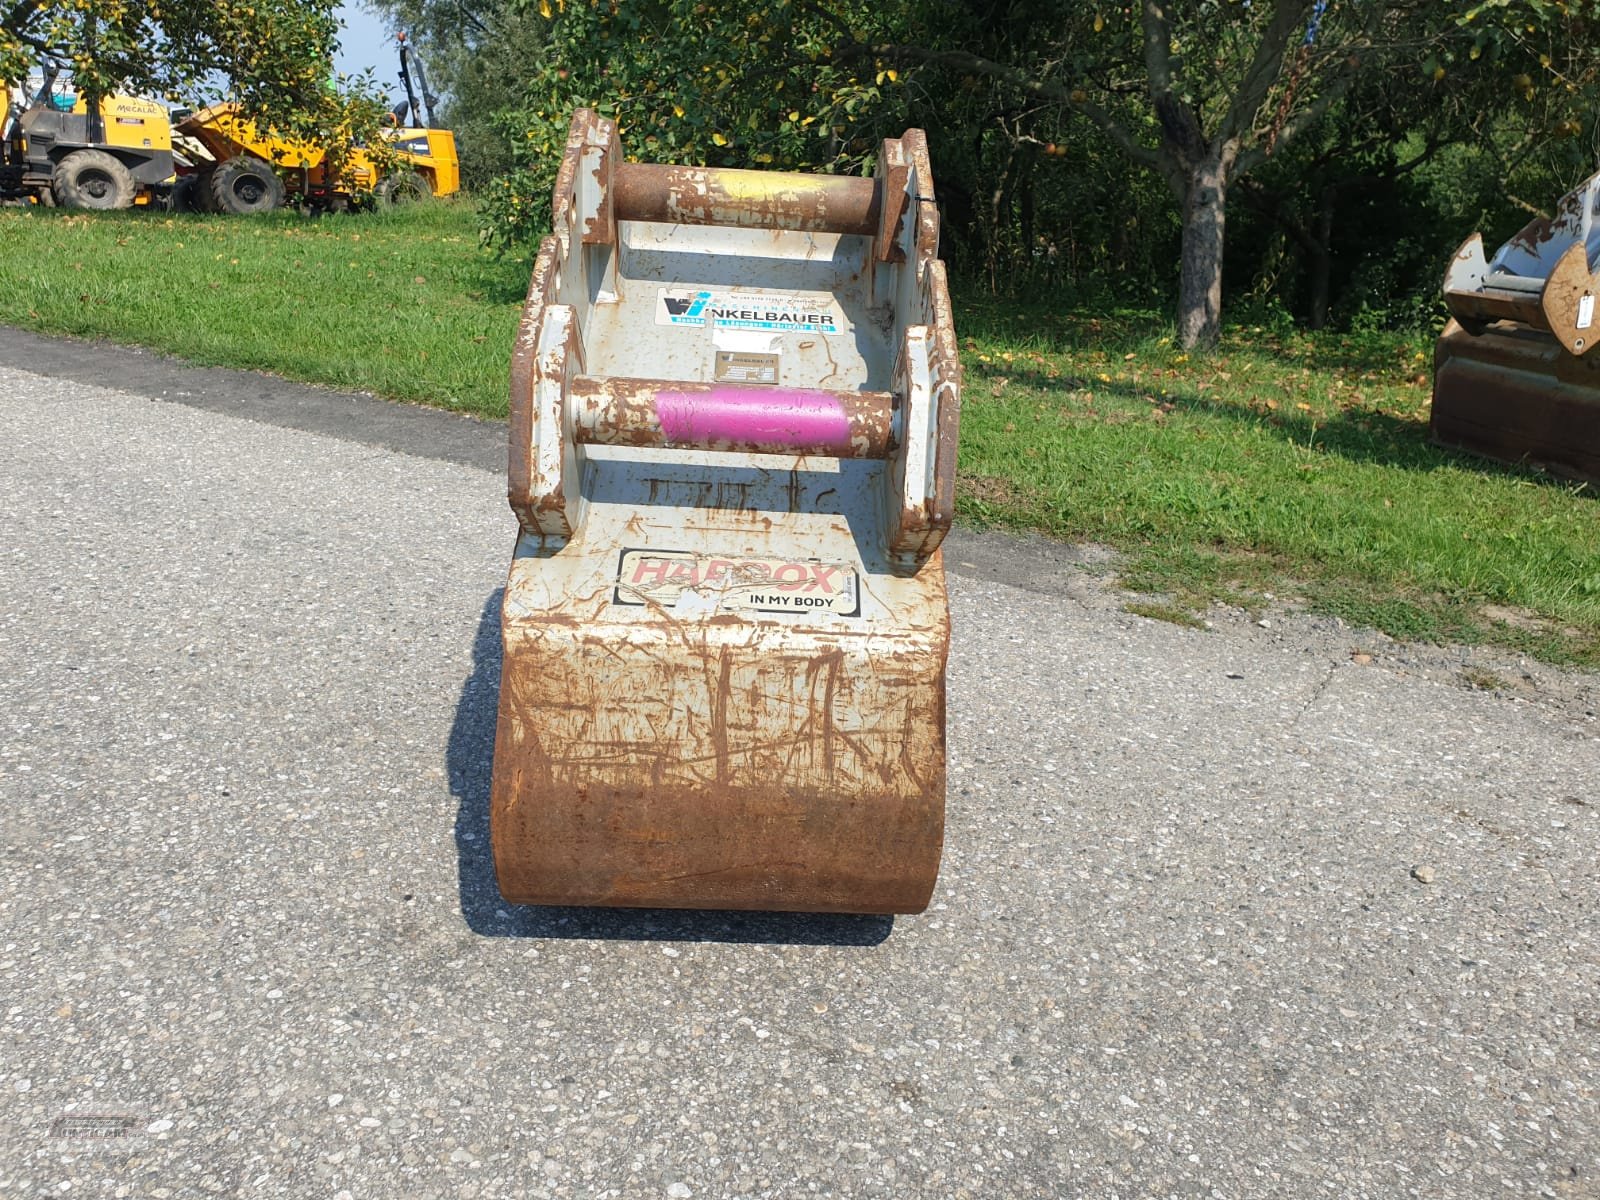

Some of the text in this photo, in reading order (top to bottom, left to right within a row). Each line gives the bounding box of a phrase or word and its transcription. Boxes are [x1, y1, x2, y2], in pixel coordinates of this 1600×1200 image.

[750, 594, 834, 608] IN MY BODY
